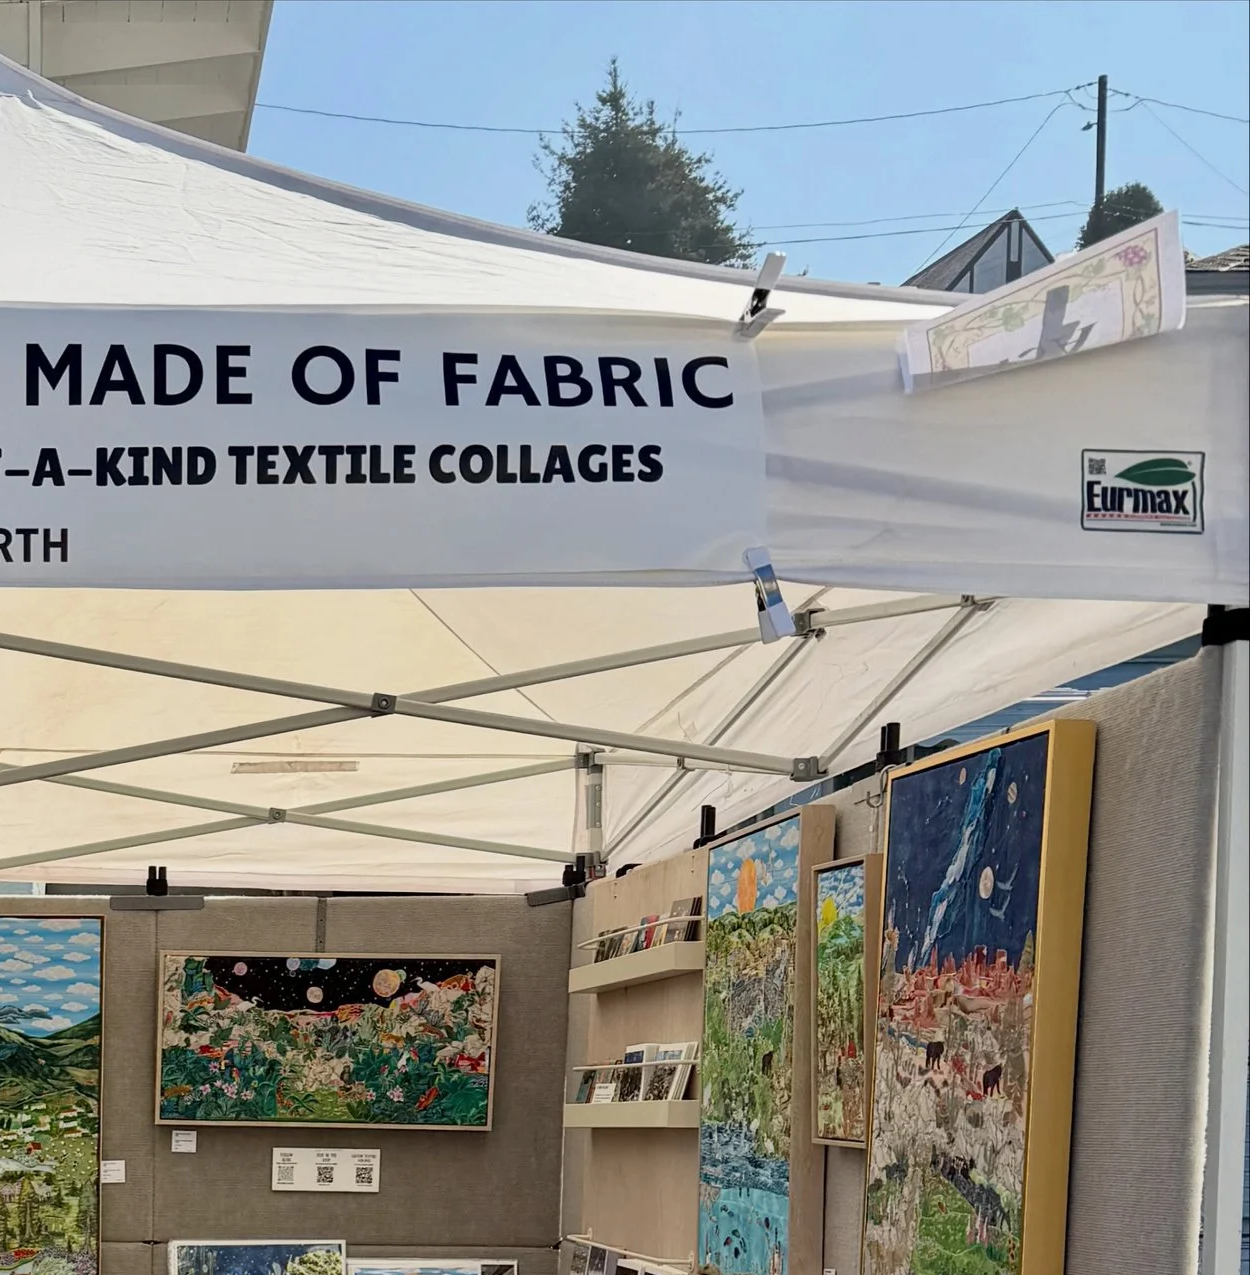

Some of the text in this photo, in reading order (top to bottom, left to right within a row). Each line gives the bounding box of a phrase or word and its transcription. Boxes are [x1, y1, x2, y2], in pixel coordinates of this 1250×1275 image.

[26, 344, 252, 405] MADE
[292, 346, 400, 405] OF
[443, 352, 733, 408] FABRIC
[228, 445, 415, 484] TEXTILE
[429, 445, 663, 483] COLLAGES
[1086, 480, 1190, 515] Eurmax
